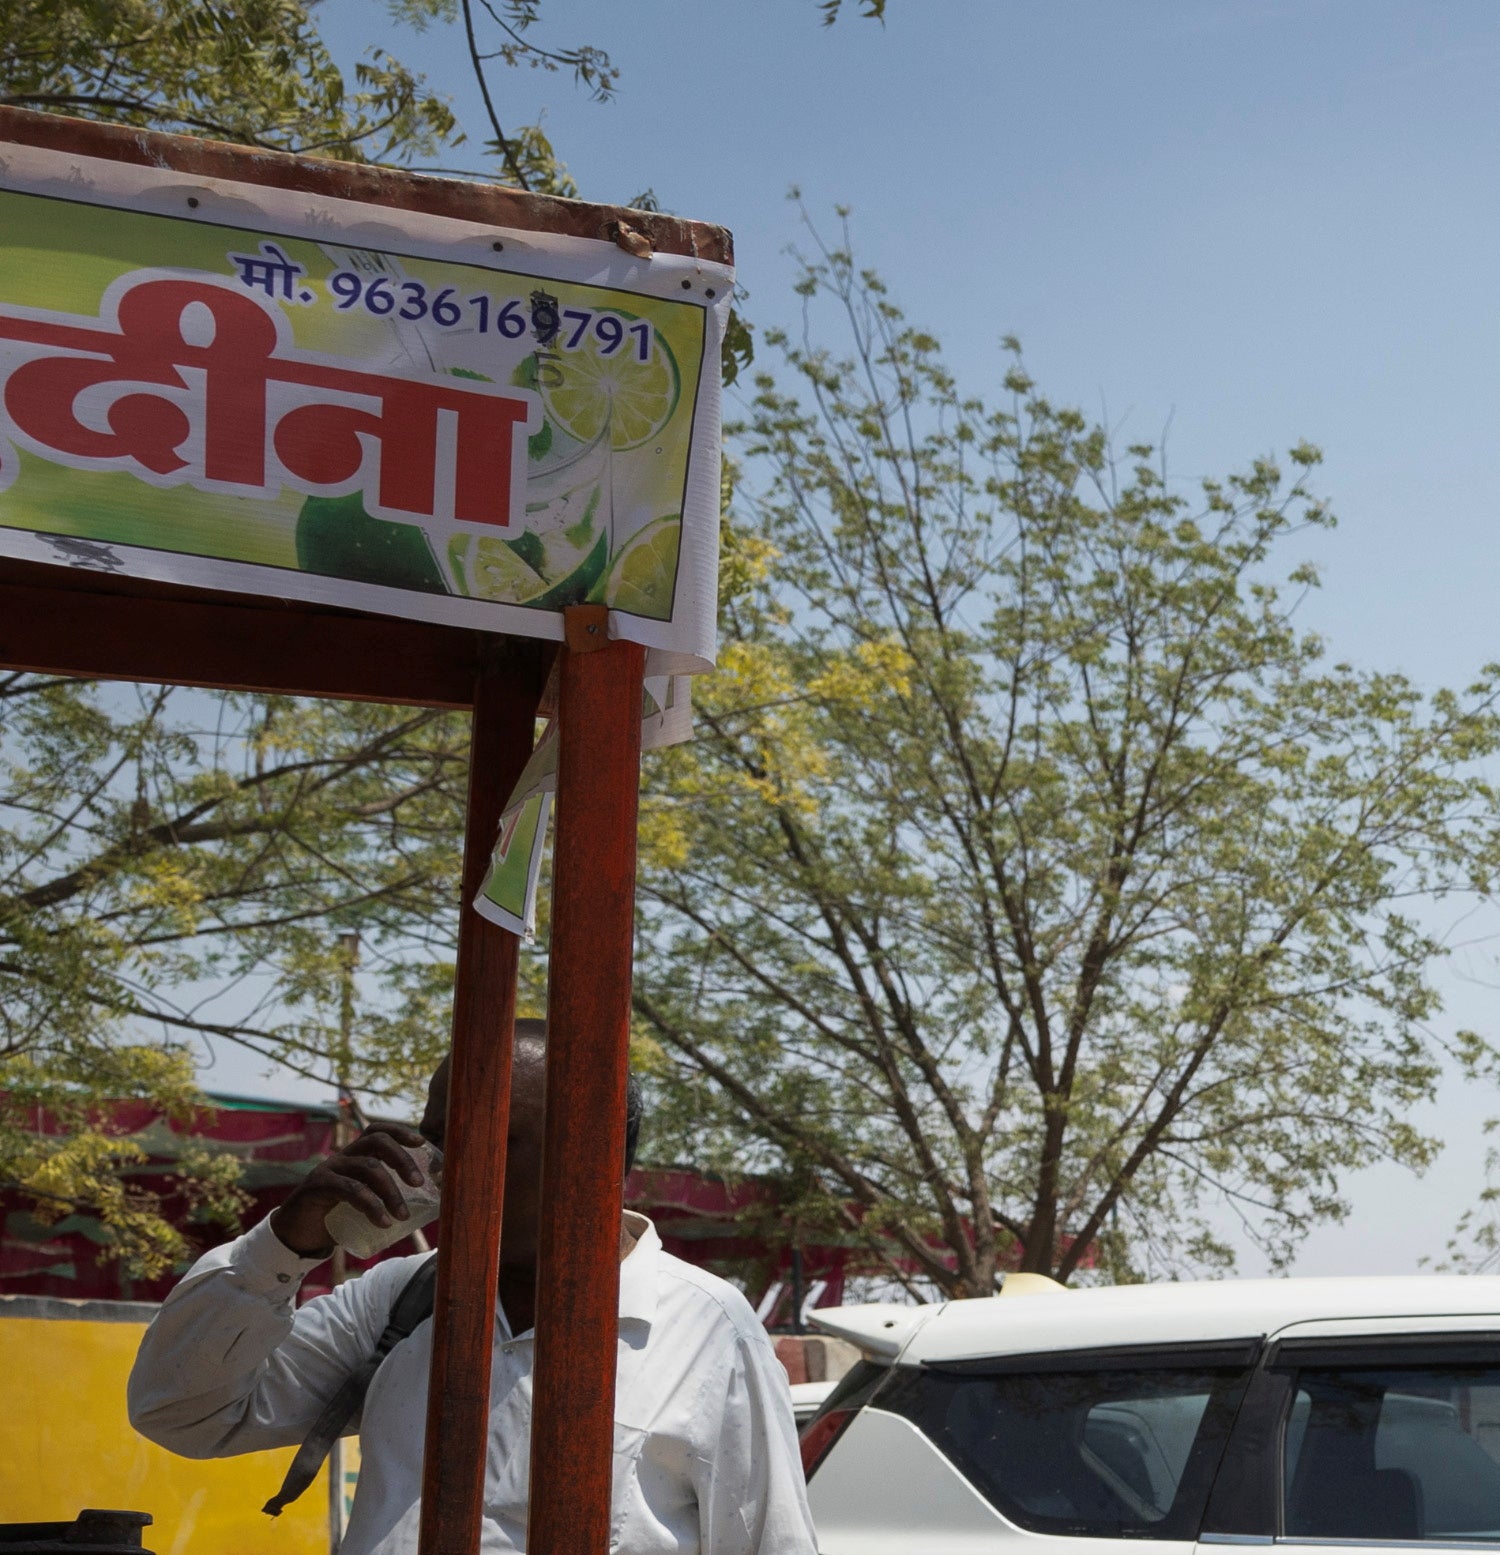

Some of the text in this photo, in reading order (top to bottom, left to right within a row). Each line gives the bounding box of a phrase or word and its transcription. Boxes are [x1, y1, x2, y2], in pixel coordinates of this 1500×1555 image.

[227, 245, 651, 361] मो. 9636169791
[0, 279, 528, 528] दीना
